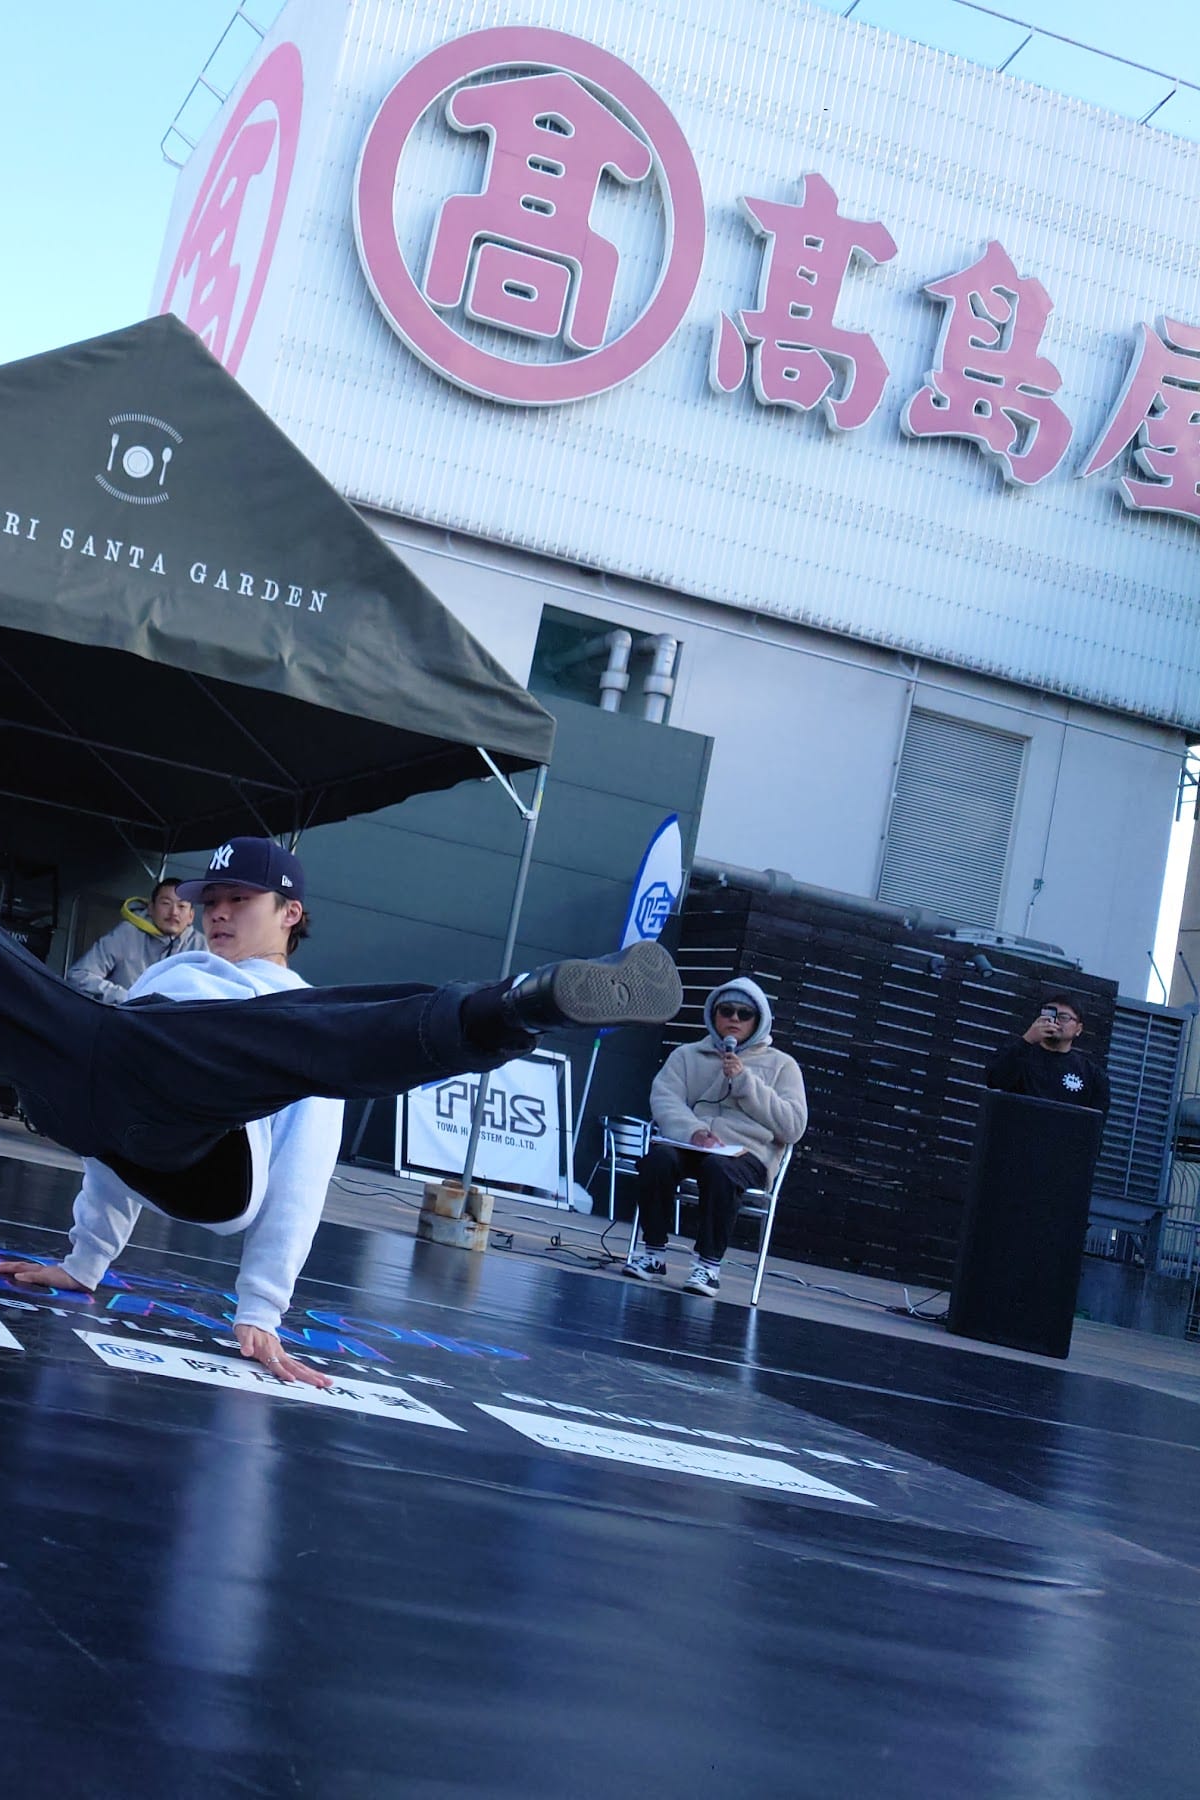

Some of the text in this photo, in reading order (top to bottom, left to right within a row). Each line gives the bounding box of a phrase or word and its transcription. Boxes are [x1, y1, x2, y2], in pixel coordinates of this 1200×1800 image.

[59, 529, 167, 575] SANTA
[190, 562, 328, 613] GARDEN
[436, 1120, 458, 1135] TOWA
[212, 1337, 455, 1389] BTTLE
